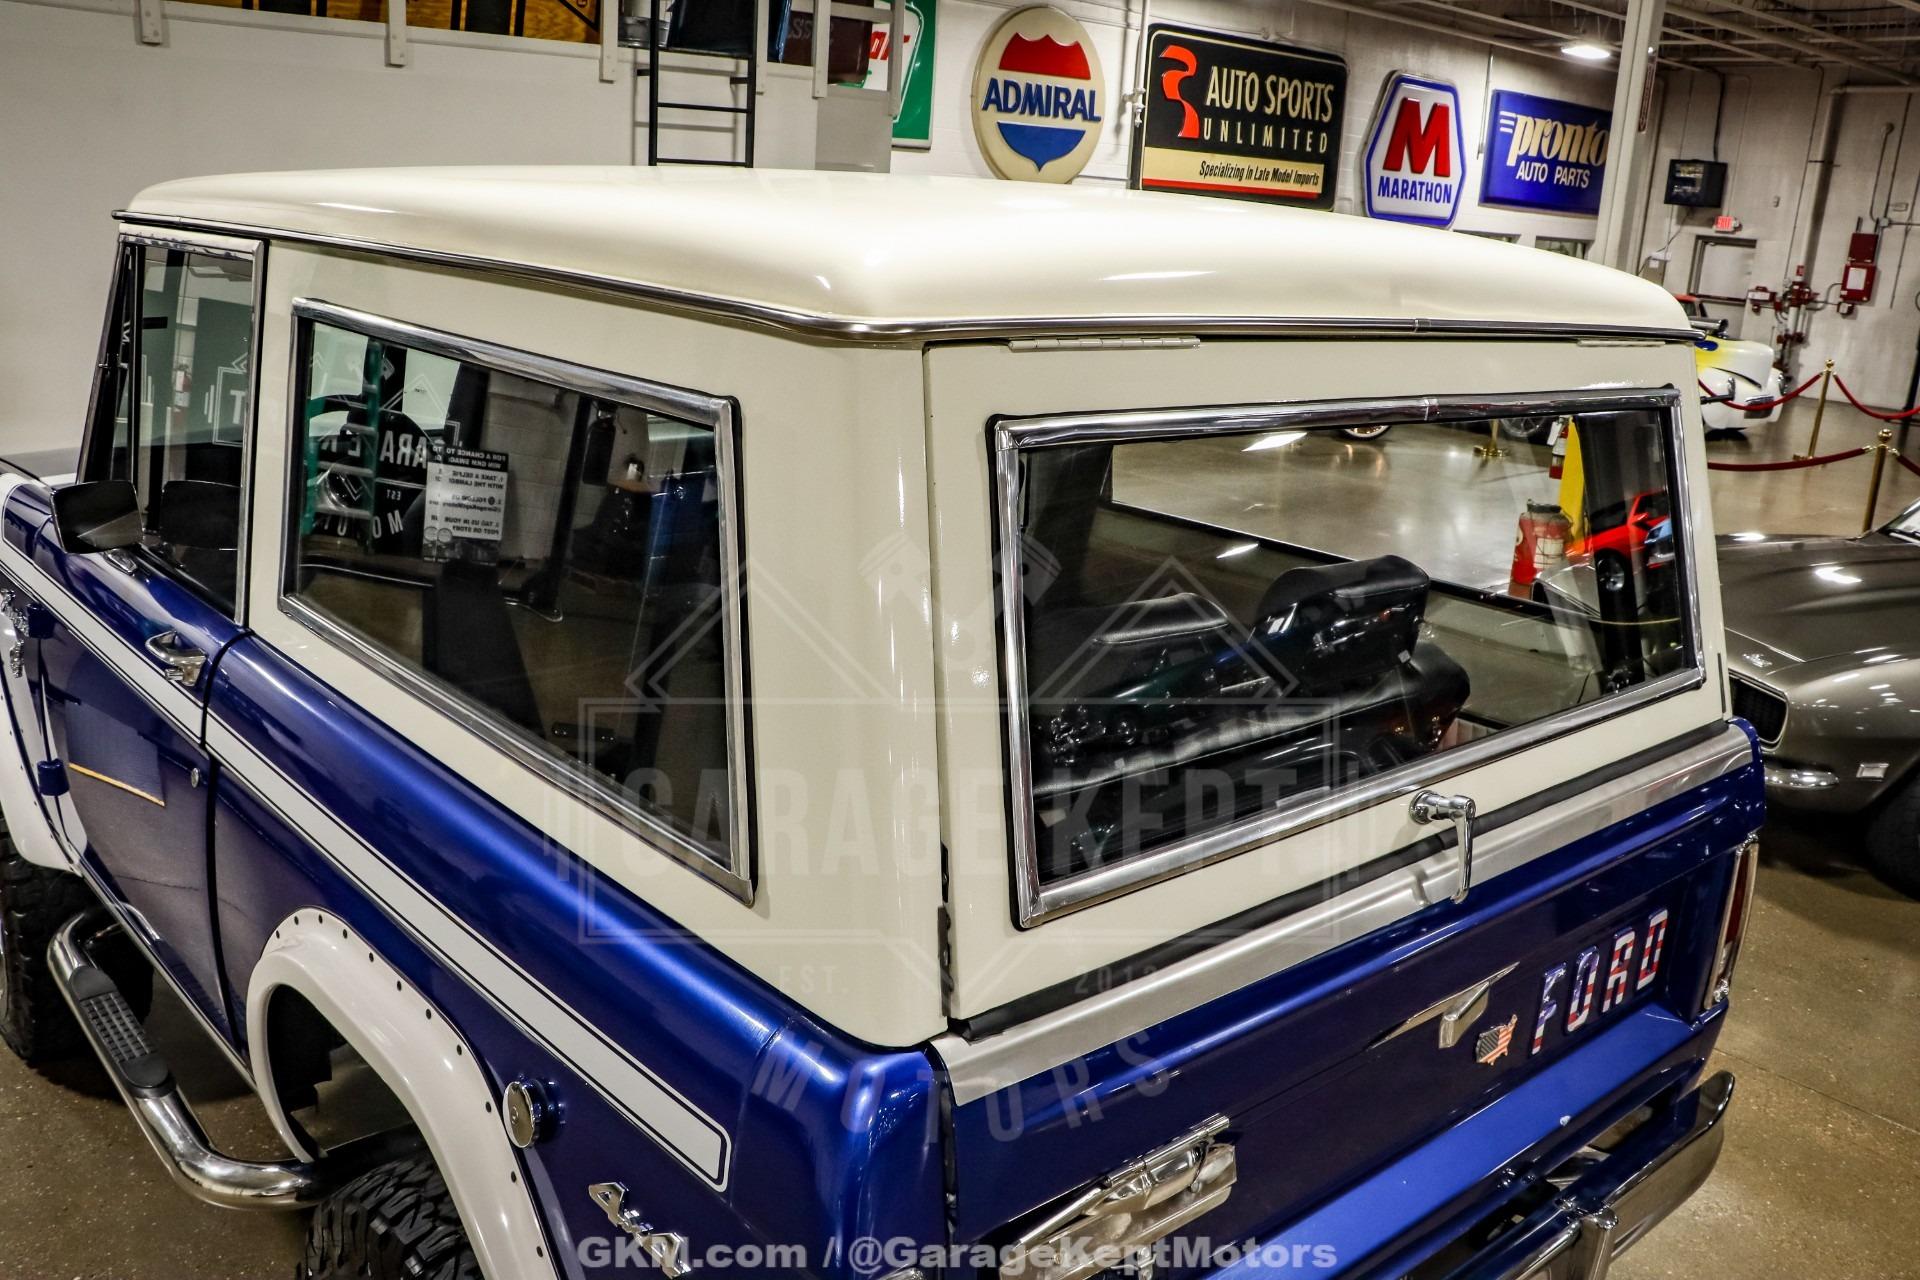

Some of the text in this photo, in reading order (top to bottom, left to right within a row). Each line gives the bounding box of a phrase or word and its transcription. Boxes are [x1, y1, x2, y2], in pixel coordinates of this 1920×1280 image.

[981, 76, 1102, 122] ADMIRAL
[1205, 65, 1335, 123] AUTO SPORTS
[1203, 117, 1329, 154] UNLIMITED
[1382, 97, 1451, 178] M
[1506, 114, 1609, 167] pronto
[1199, 160, 1245, 181] Specializing
[1254, 166, 1269, 181] Late
[1271, 167, 1293, 183] Model
[1294, 170, 1319, 186] Imports
[1377, 175, 1453, 204] MARATHON
[1515, 161, 1591, 189] AUTO PARTS
[1531, 909, 1669, 1056] FORD
